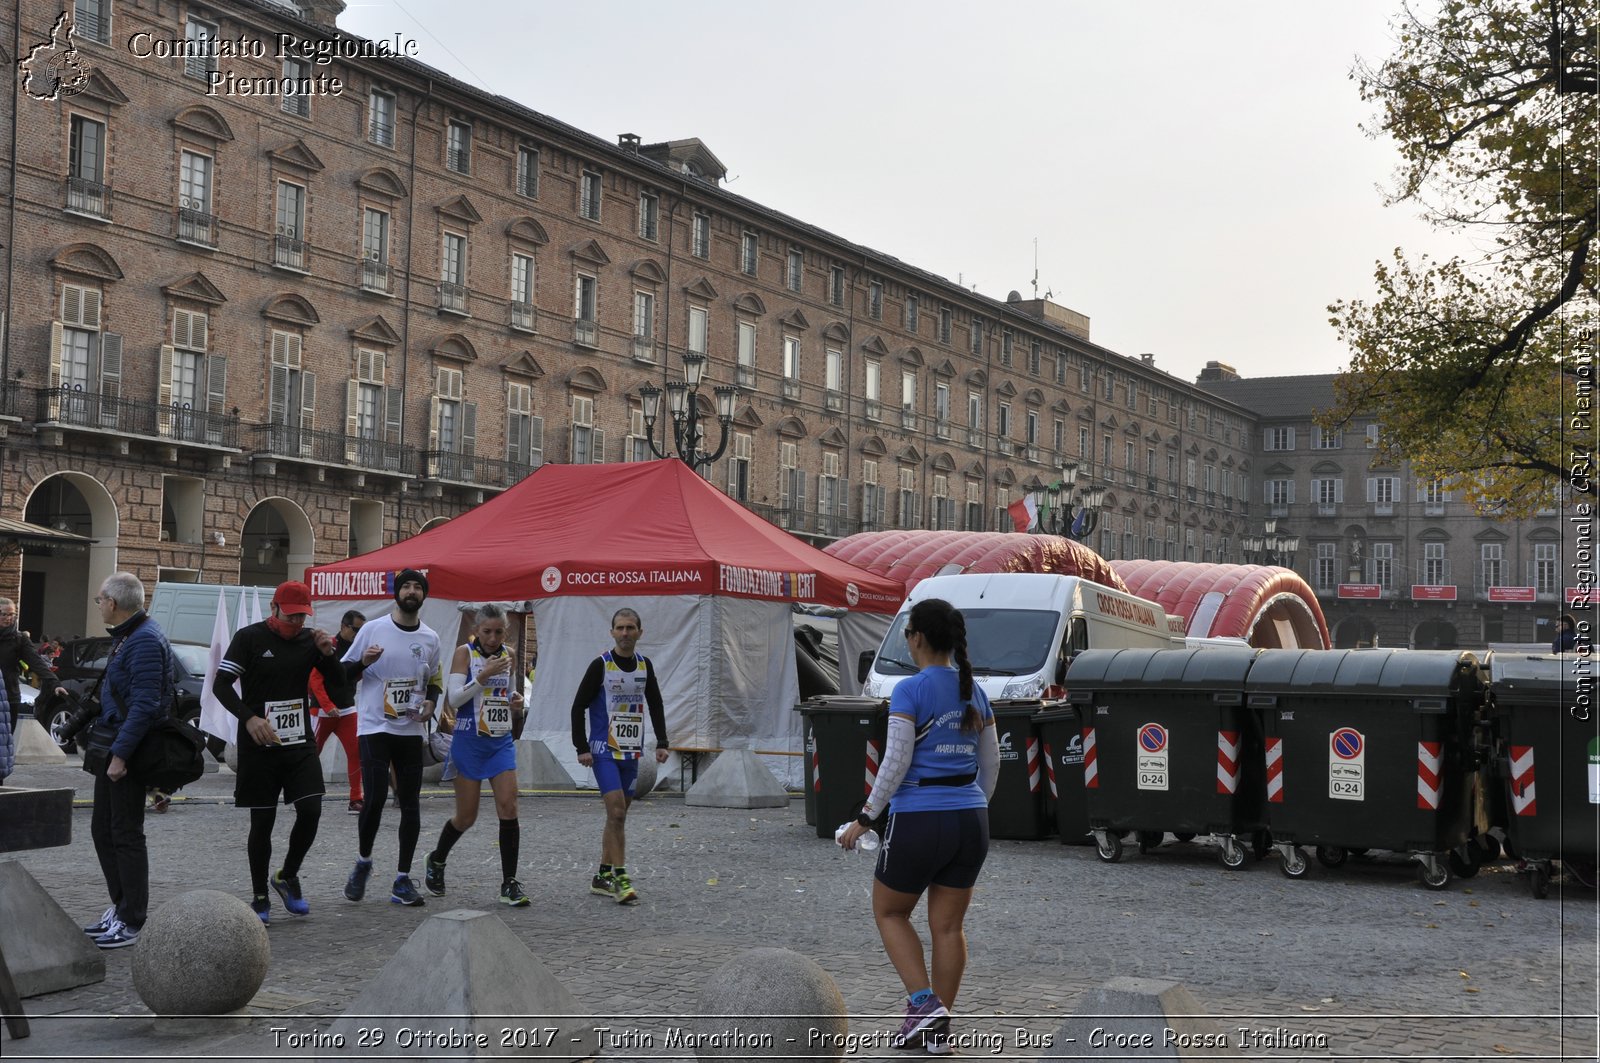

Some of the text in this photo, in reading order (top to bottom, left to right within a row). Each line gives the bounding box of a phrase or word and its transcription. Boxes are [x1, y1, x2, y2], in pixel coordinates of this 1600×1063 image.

[311, 571, 386, 596] FONDAZIONE
[566, 569, 702, 585] CROCE ROSSA ITALIANA
[720, 564, 816, 598] FONDAZIONE CRT
[1096, 592, 1117, 616] CROCE
[1115, 598, 1134, 621] ROSSA
[391, 689, 410, 704] 128
[275, 712, 300, 729] 1281
[487, 708, 508, 722] 1283
[615, 724, 639, 738] 1260
[934, 744, 955, 754] MARIA
[1141, 774, 1164, 785] 0-24
[1333, 782, 1359, 794] 0-24
